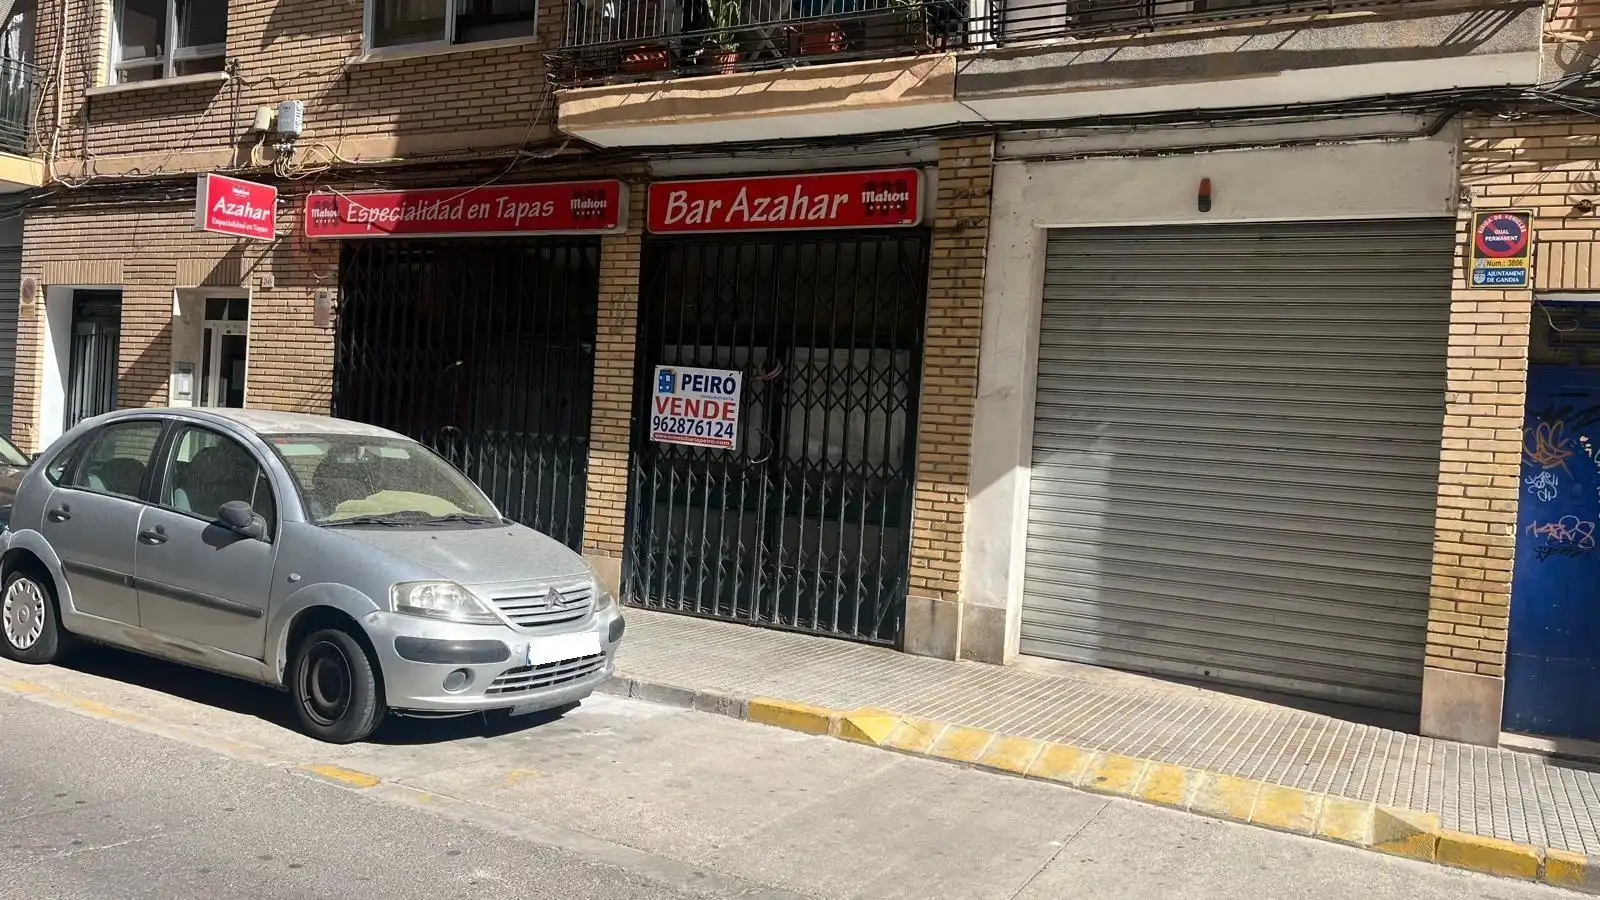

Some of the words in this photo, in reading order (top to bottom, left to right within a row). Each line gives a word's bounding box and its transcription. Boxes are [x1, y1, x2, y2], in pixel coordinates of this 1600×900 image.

[213, 196, 270, 221] Azahar
[570, 198, 607, 210] Mahou
[664, 189, 721, 225] Bar
[725, 184, 848, 222] Azahar
[861, 189, 909, 204] Mahou
[346, 198, 465, 231] Especialidad
[467, 203, 490, 219] en
[496, 196, 554, 227] Tapas
[681, 373, 736, 395] PEIRÓ
[655, 395, 736, 421] VENDE
[653, 415, 734, 439] 962876124
